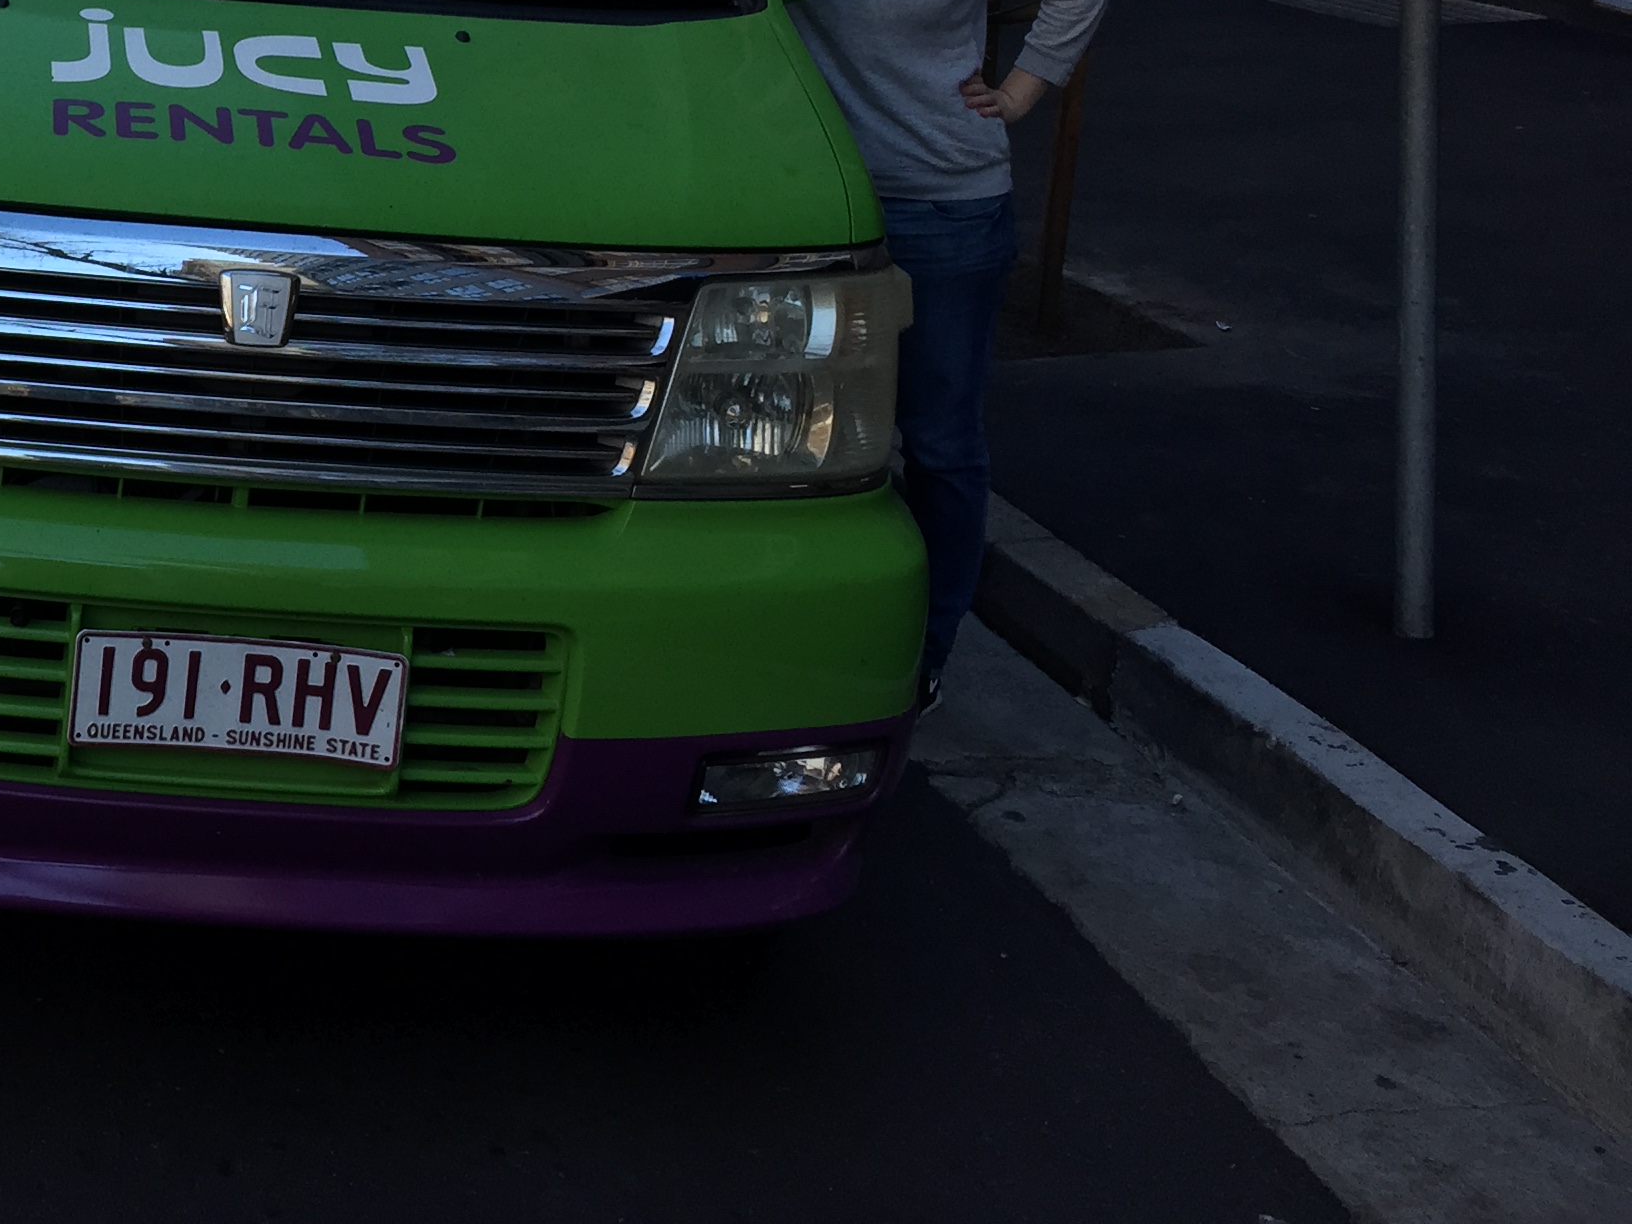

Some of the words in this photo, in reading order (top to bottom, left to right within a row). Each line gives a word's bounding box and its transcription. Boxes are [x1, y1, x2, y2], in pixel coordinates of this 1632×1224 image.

[52, 98, 457, 164] RENTALS
[86, 722, 206, 744] QUEENSLAND
[225, 729, 316, 752] SUNSHINE
[326, 737, 382, 761] STATE
